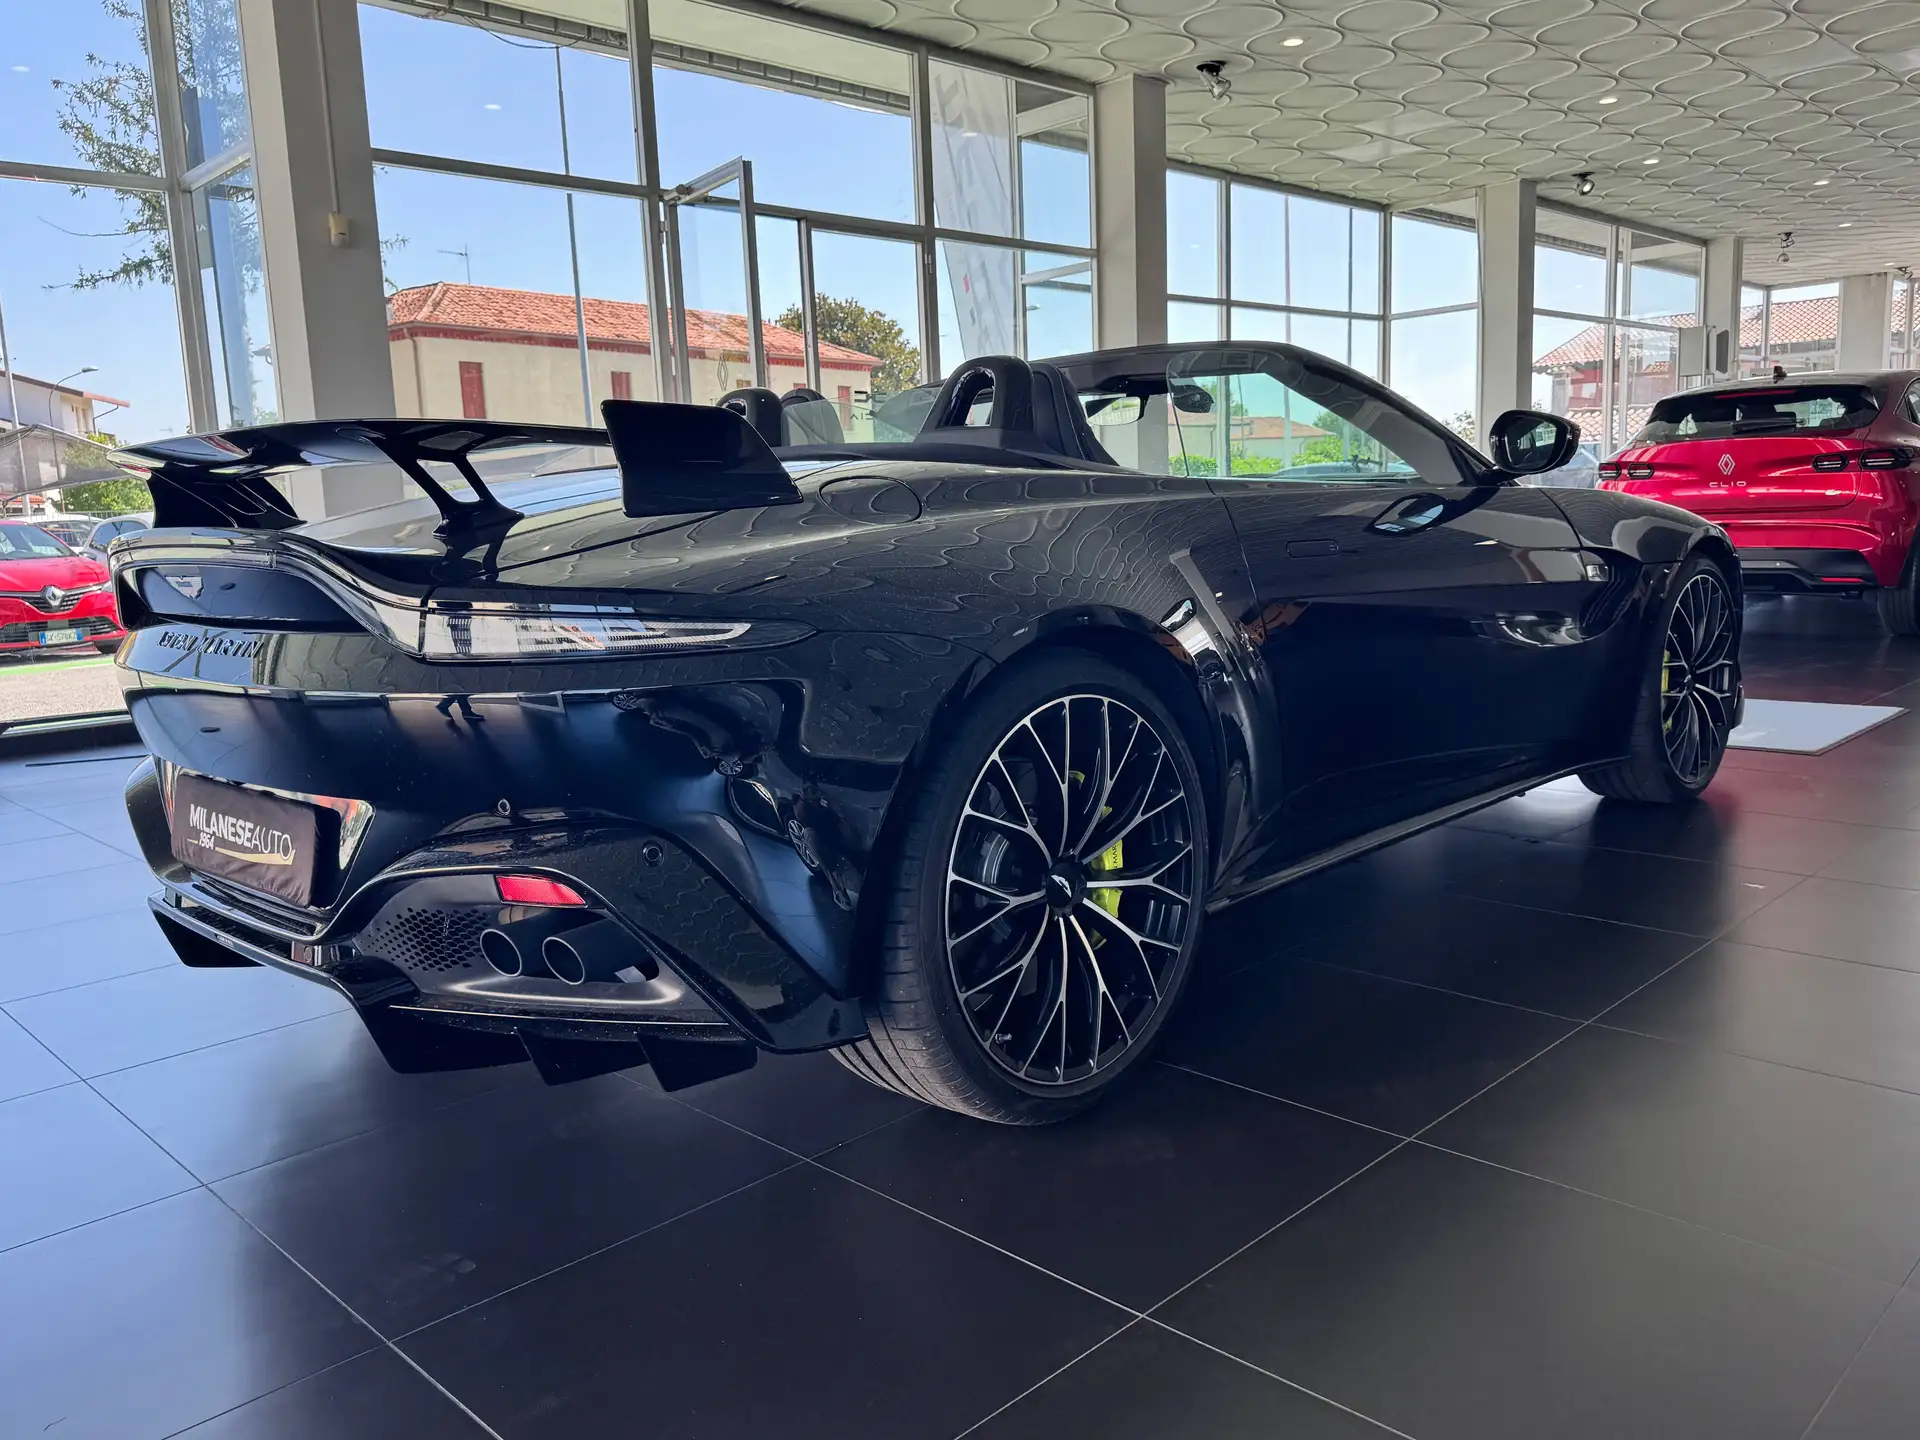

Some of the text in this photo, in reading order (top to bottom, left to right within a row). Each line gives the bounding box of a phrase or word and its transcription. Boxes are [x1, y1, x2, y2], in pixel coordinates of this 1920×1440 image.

[197, 636, 265, 658] MARTIN
[189, 803, 293, 860] MILANESEAUTO
[199, 831, 216, 850] 1964
